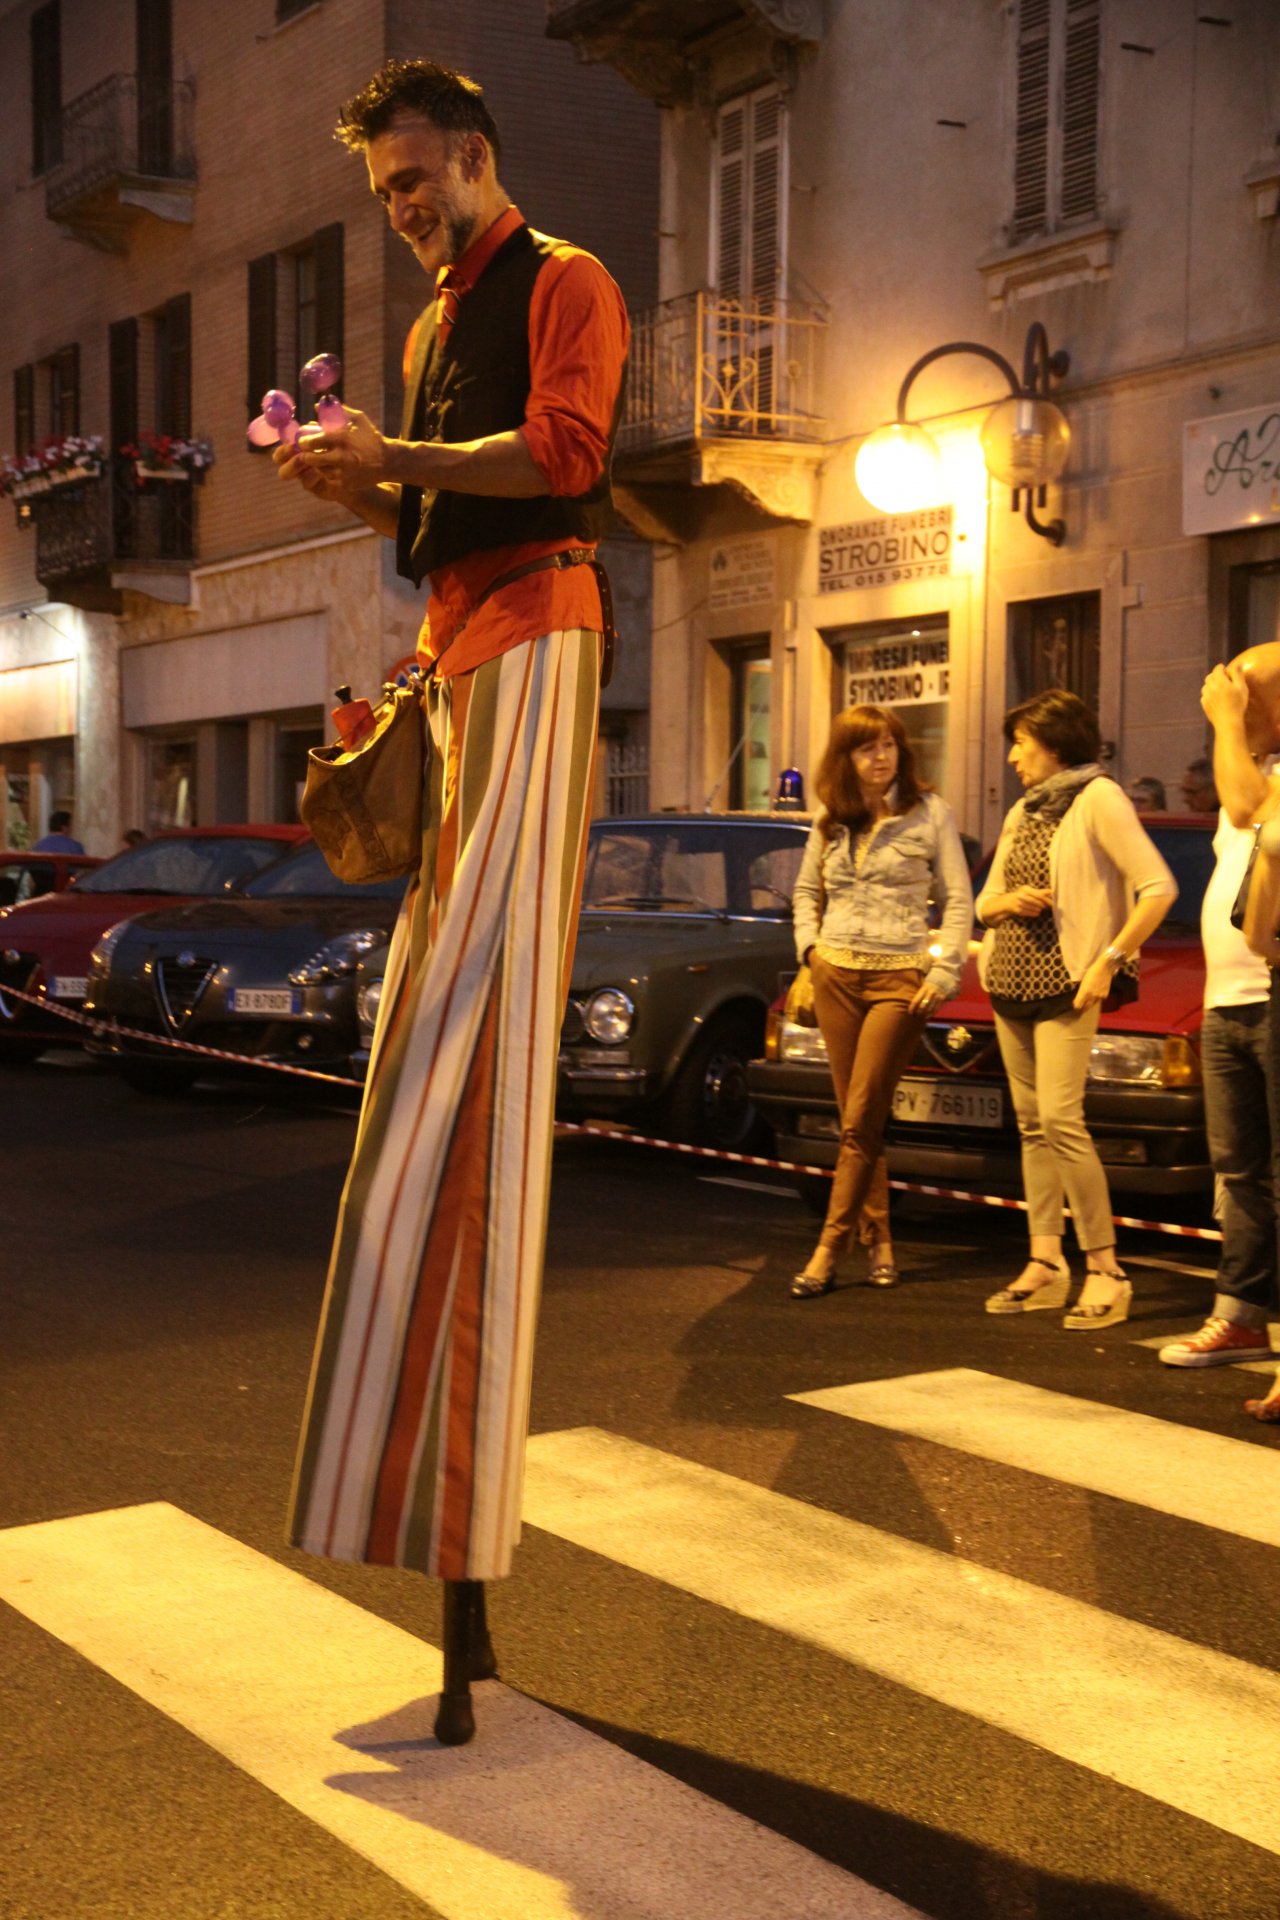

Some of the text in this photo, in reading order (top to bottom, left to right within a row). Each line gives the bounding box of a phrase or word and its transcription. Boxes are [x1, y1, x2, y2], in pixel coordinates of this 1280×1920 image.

[819, 530, 949, 574] STROBINO
[855, 571, 886, 587] 015
[849, 672, 923, 706] STROBINO
